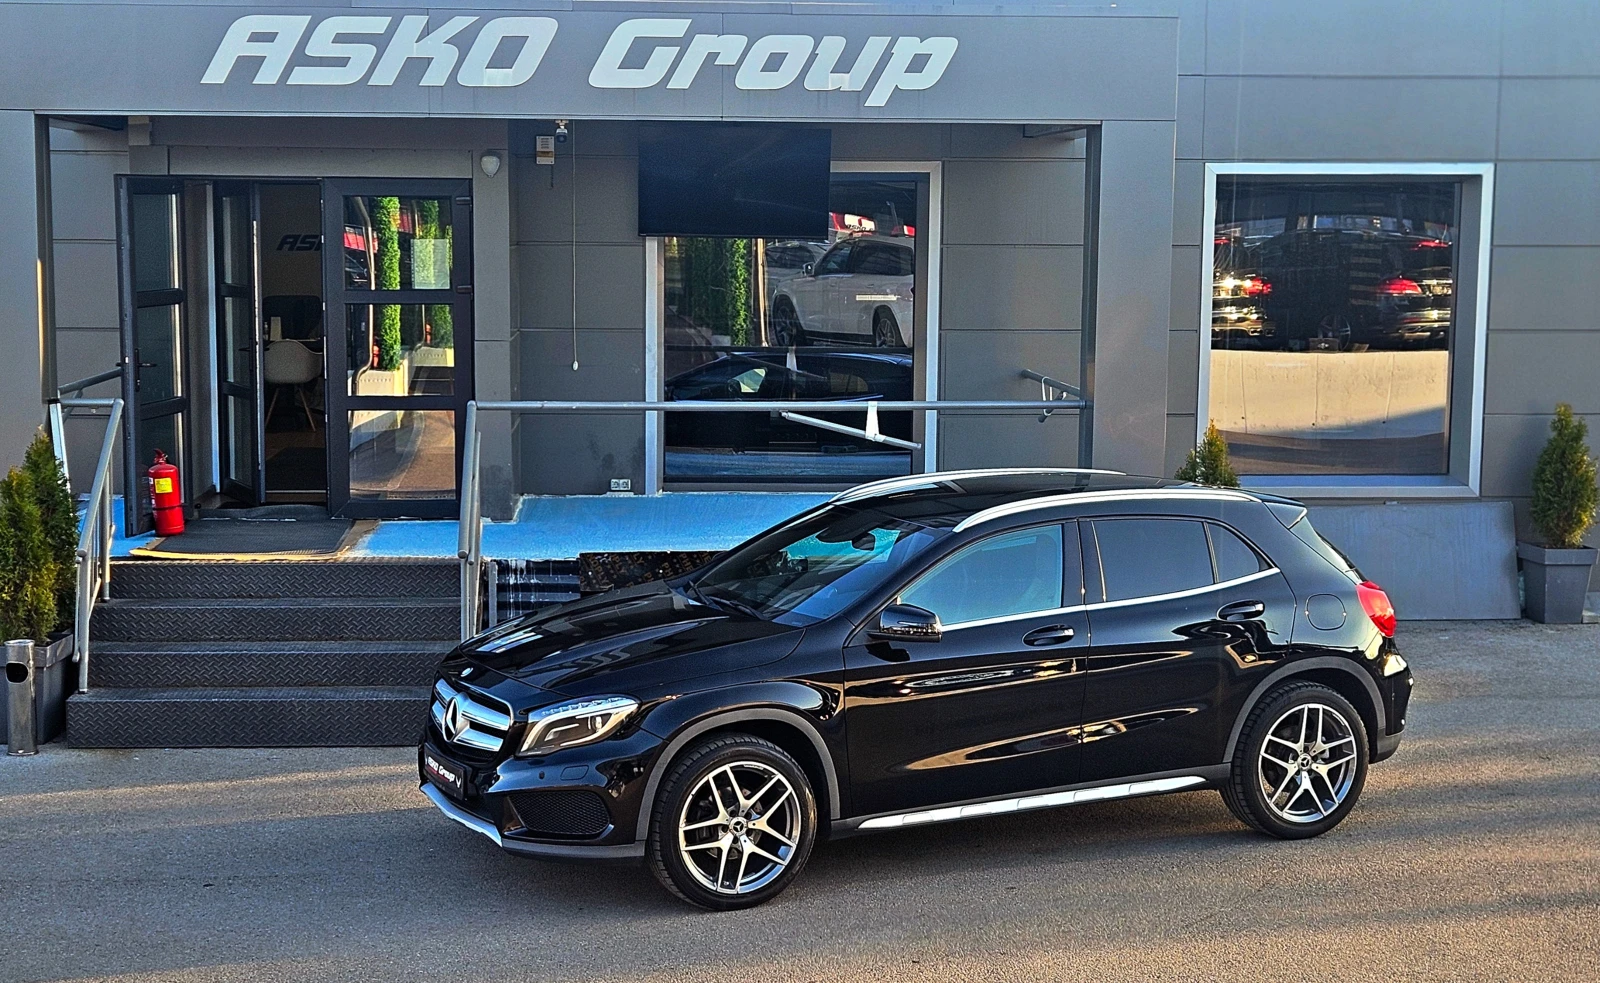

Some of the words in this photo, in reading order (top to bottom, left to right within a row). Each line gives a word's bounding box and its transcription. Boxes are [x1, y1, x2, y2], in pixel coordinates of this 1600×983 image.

[201, 15, 558, 87] ASKO
[588, 18, 959, 107] Group
[276, 234, 320, 251] AS
